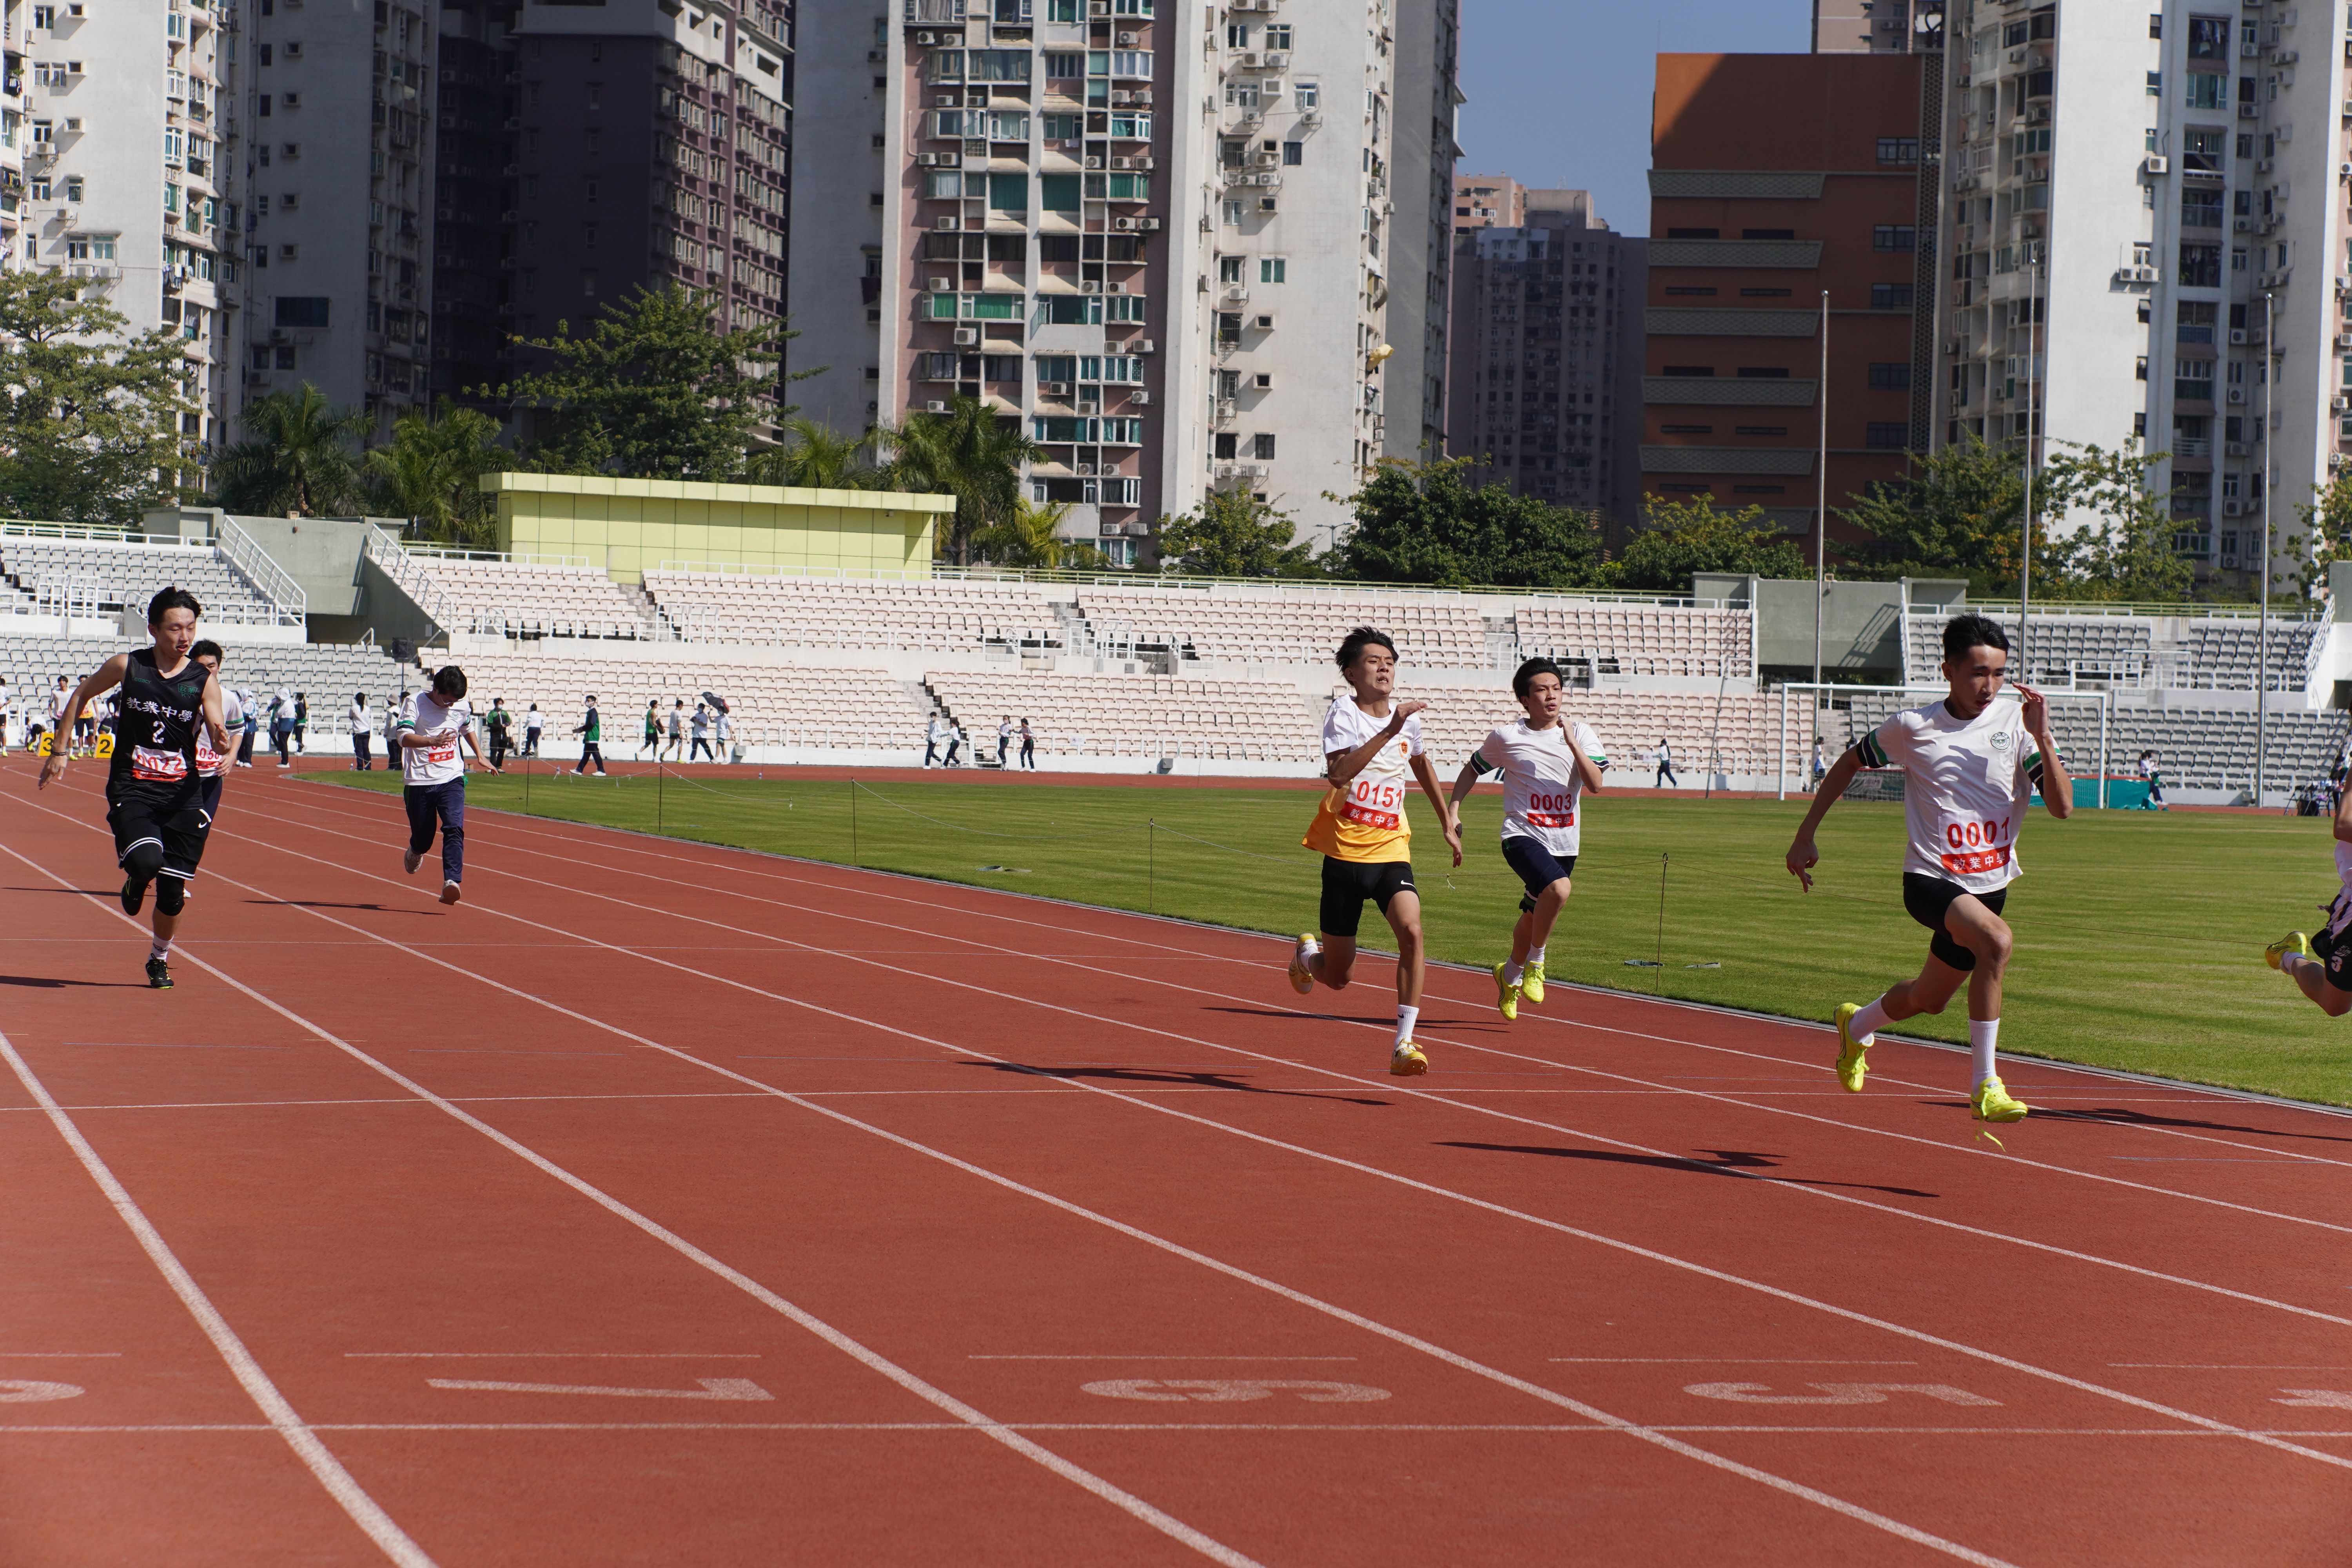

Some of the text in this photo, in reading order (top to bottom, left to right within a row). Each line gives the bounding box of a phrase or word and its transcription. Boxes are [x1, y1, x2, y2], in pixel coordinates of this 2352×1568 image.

[127, 697, 192, 722] 教業中學
[152, 720, 165, 743] 2
[43, 737, 53, 751] 3
[100, 739, 110, 753] 2
[1357, 781, 1402, 809] 0151
[1531, 794, 1572, 811] 0003
[1349, 808, 1395, 826] 教業中學
[1534, 816, 1570, 825] 教業中學
[1947, 817, 2009, 848] 0001
[1953, 851, 2005, 870] 教業中學
